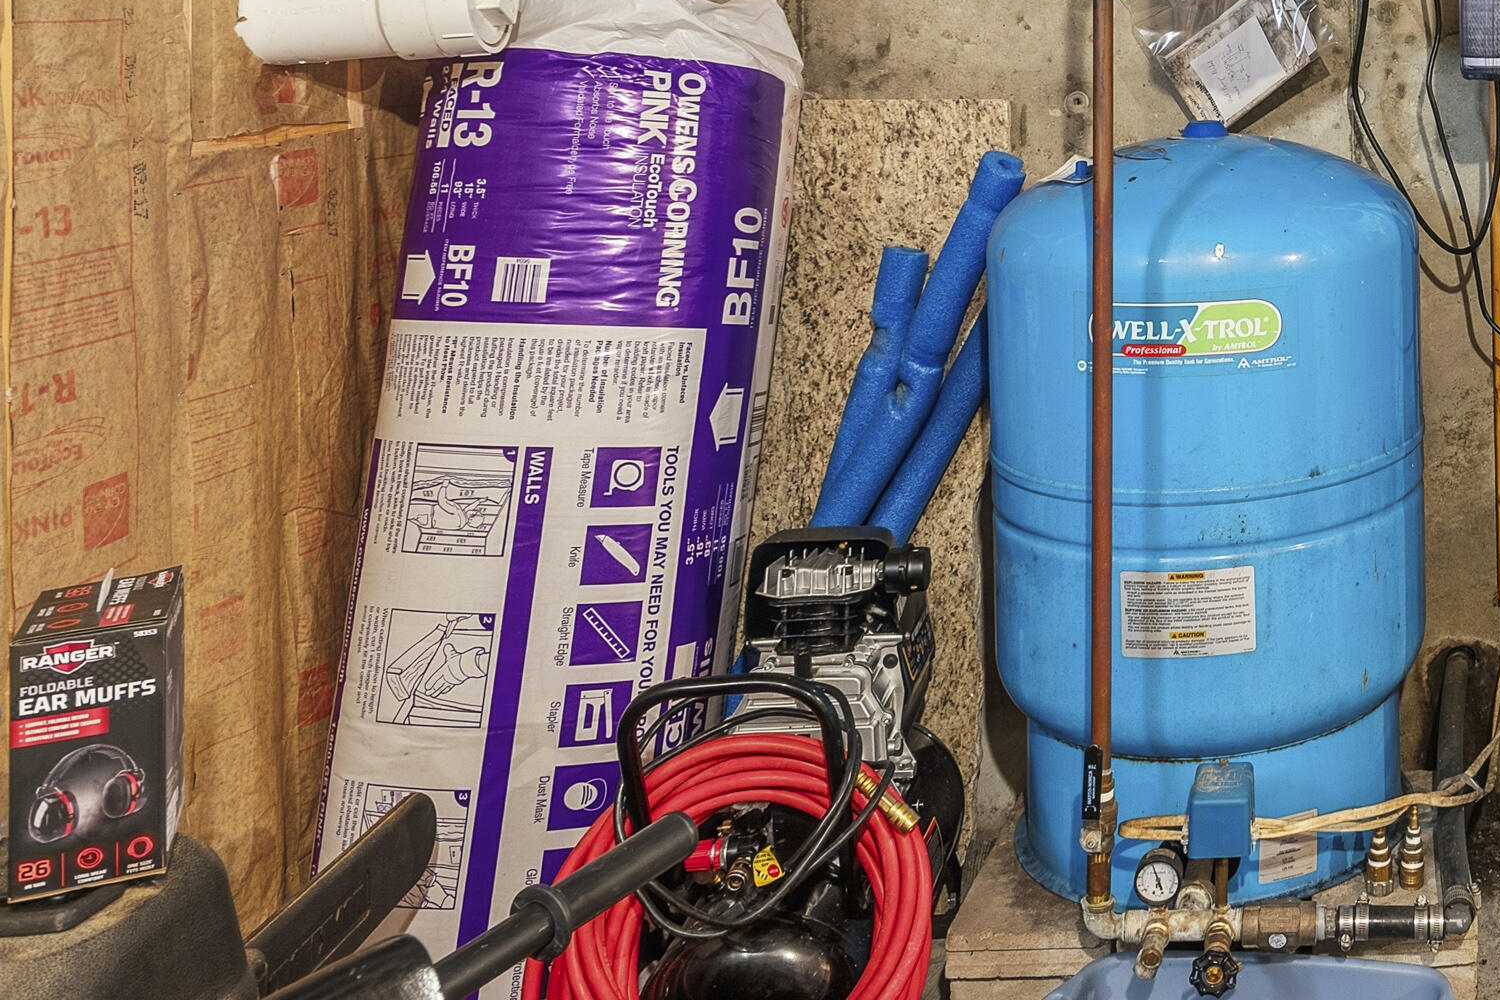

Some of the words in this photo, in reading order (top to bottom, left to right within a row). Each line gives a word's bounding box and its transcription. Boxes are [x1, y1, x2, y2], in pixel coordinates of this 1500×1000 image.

[441, 80, 459, 132] FACED
[453, 61, 504, 147] R-13
[637, 69, 672, 145] PINK
[425, 99, 443, 149] Walls
[671, 72, 706, 175] OWENS
[627, 150, 649, 228] INSULATION
[642, 153, 665, 228] EcoTouch
[18, 204, 72, 238] -13
[655, 179, 698, 308] CORNING
[440, 244, 476, 307] BF10
[721, 207, 762, 325] BF10
[448, 350, 456, 374] Means
[515, 338, 526, 370] Handling
[675, 342, 685, 376] Insulation
[684, 342, 693, 363] Faced
[1125, 346, 1183, 355] Professional
[1225, 341, 1257, 351] AMTROL
[442, 375, 453, 414] Resistance
[514, 372, 522, 383] the
[590, 376, 599, 402] Needed
[509, 385, 520, 420] Insulation
[596, 379, 607, 413] Insulation
[523, 451, 547, 505] WALLS
[580, 448, 594, 474] Tape
[661, 445, 680, 497] TOOLS
[576, 474, 591, 508] Measure
[657, 501, 672, 533] YOU
[567, 545, 581, 568] Knife
[652, 536, 668, 571] MAY
[647, 574, 664, 616] NEED
[557, 606, 575, 641] Straight
[643, 619, 658, 652] FOR
[21, 645, 114, 670] RANGER
[554, 642, 570, 667] Edge
[20, 676, 94, 697] FOLDABLE
[636, 656, 654, 689] YOU
[19, 694, 68, 716] EAR
[75, 679, 156, 707] MUFFS
[545, 700, 561, 733] Stapler
[537, 775, 551, 797] Dust
[532, 798, 548, 825] Mask
[19, 859, 51, 882] 26
